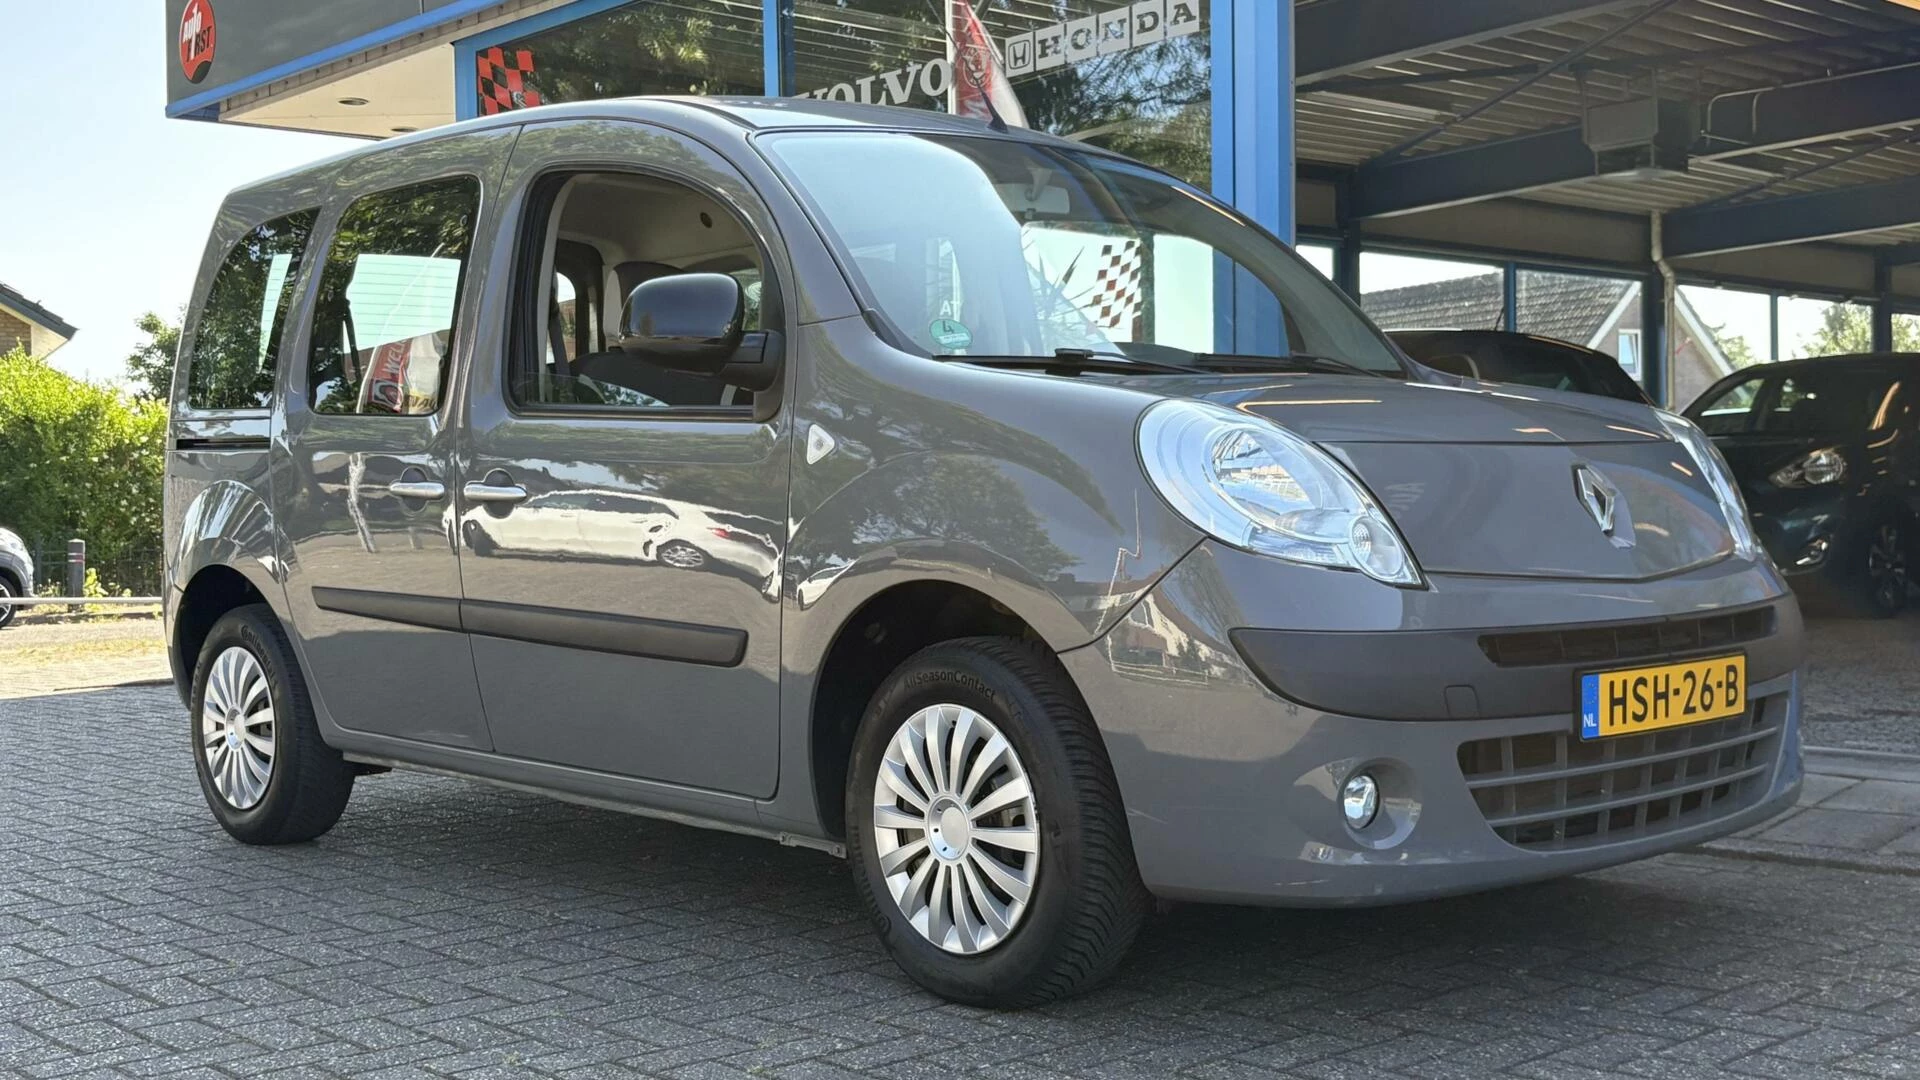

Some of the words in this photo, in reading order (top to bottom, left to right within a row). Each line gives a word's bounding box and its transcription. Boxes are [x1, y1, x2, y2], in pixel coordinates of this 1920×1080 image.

[1038, 3, 1196, 58] HONDA
[1583, 713, 1597, 728] NL
[1609, 664, 1739, 727] HSH-26-B
